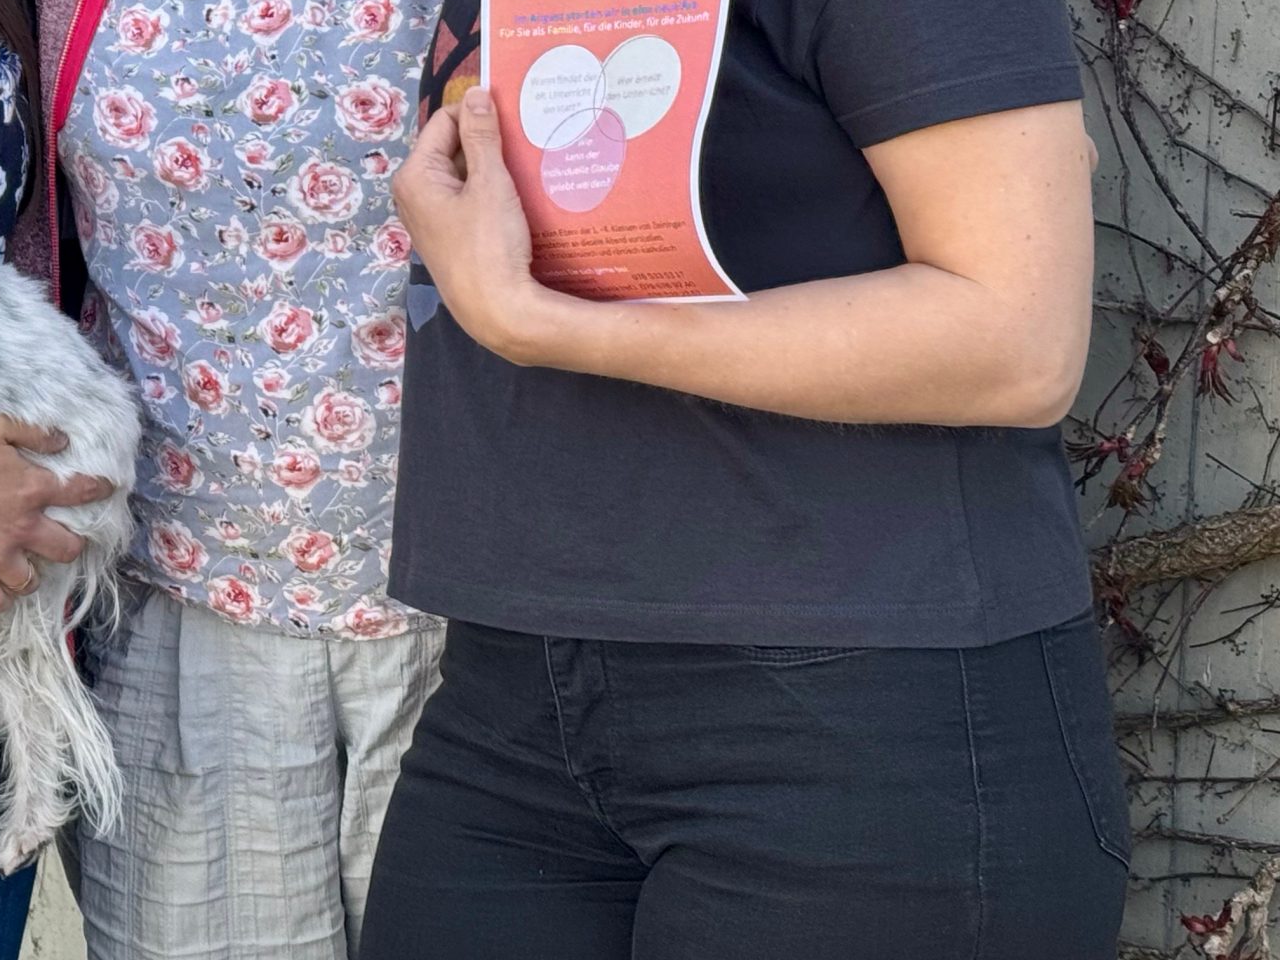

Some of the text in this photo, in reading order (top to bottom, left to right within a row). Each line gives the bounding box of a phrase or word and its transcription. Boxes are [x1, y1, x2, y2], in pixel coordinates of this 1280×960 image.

[499, 28, 514, 38] Für
[516, 26, 531, 37] Sie
[532, 26, 546, 37] als
[583, 21, 596, 32] für
[598, 20, 612, 31] die
[646, 15, 659, 27] für
[661, 15, 675, 26] die
[676, 11, 710, 25] Zukunft
